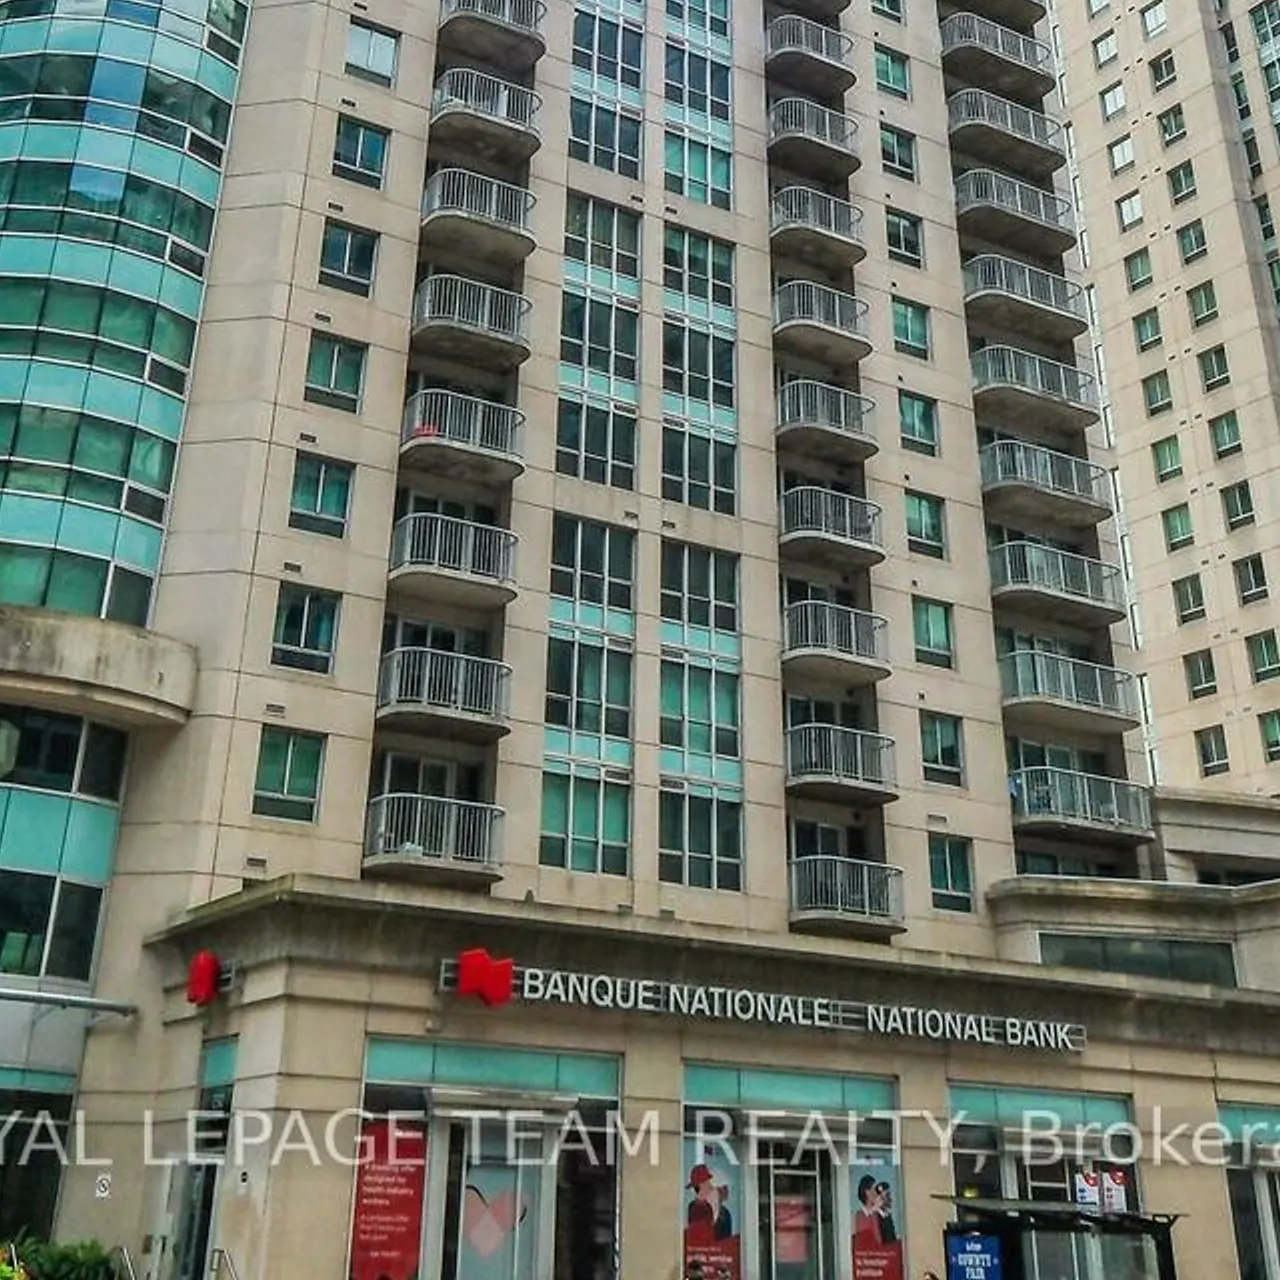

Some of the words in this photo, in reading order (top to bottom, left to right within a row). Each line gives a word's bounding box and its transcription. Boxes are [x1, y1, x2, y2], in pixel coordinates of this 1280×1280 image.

[521, 967, 656, 1011] BANQUE
[668, 983, 831, 1028] NATIONALE
[866, 1003, 996, 1044] NATIONAL
[1004, 1017, 1074, 1051] BANK
